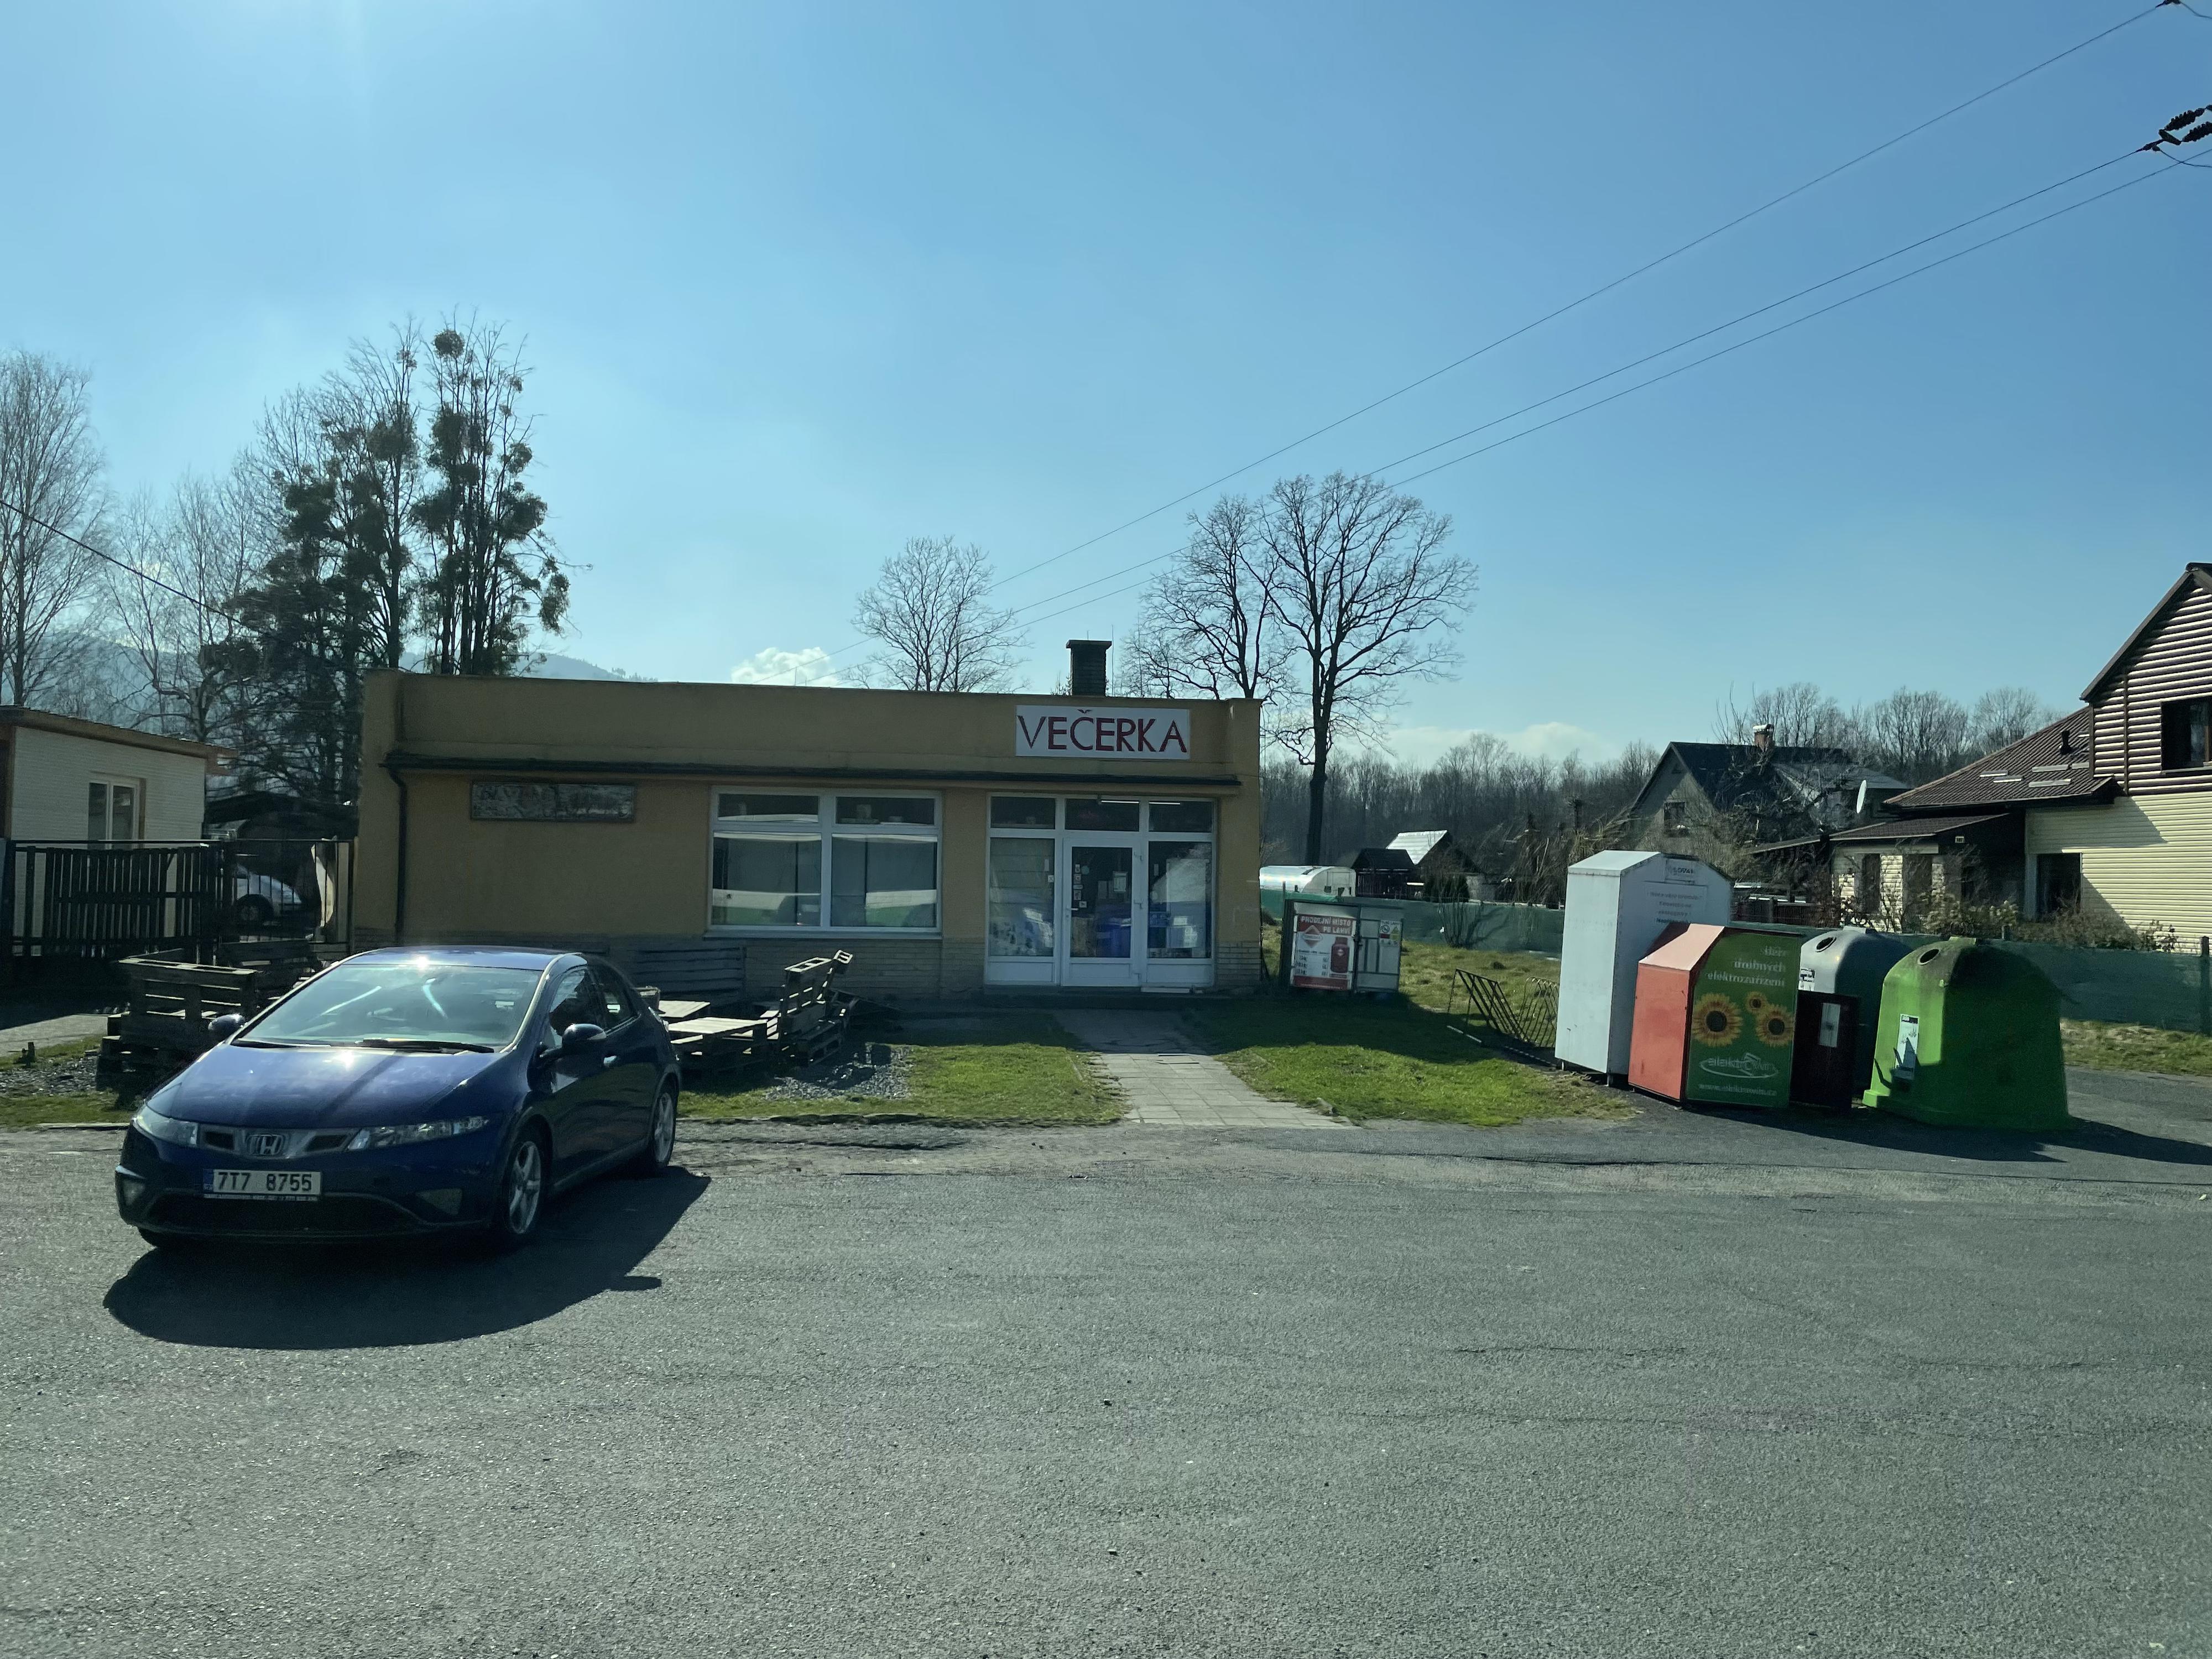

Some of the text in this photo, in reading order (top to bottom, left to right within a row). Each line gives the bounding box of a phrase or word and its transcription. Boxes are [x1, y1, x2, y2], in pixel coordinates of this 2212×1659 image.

[1016, 709, 1187, 753] VEČERKA
[218, 1172, 312, 1192] 7T7 8755
